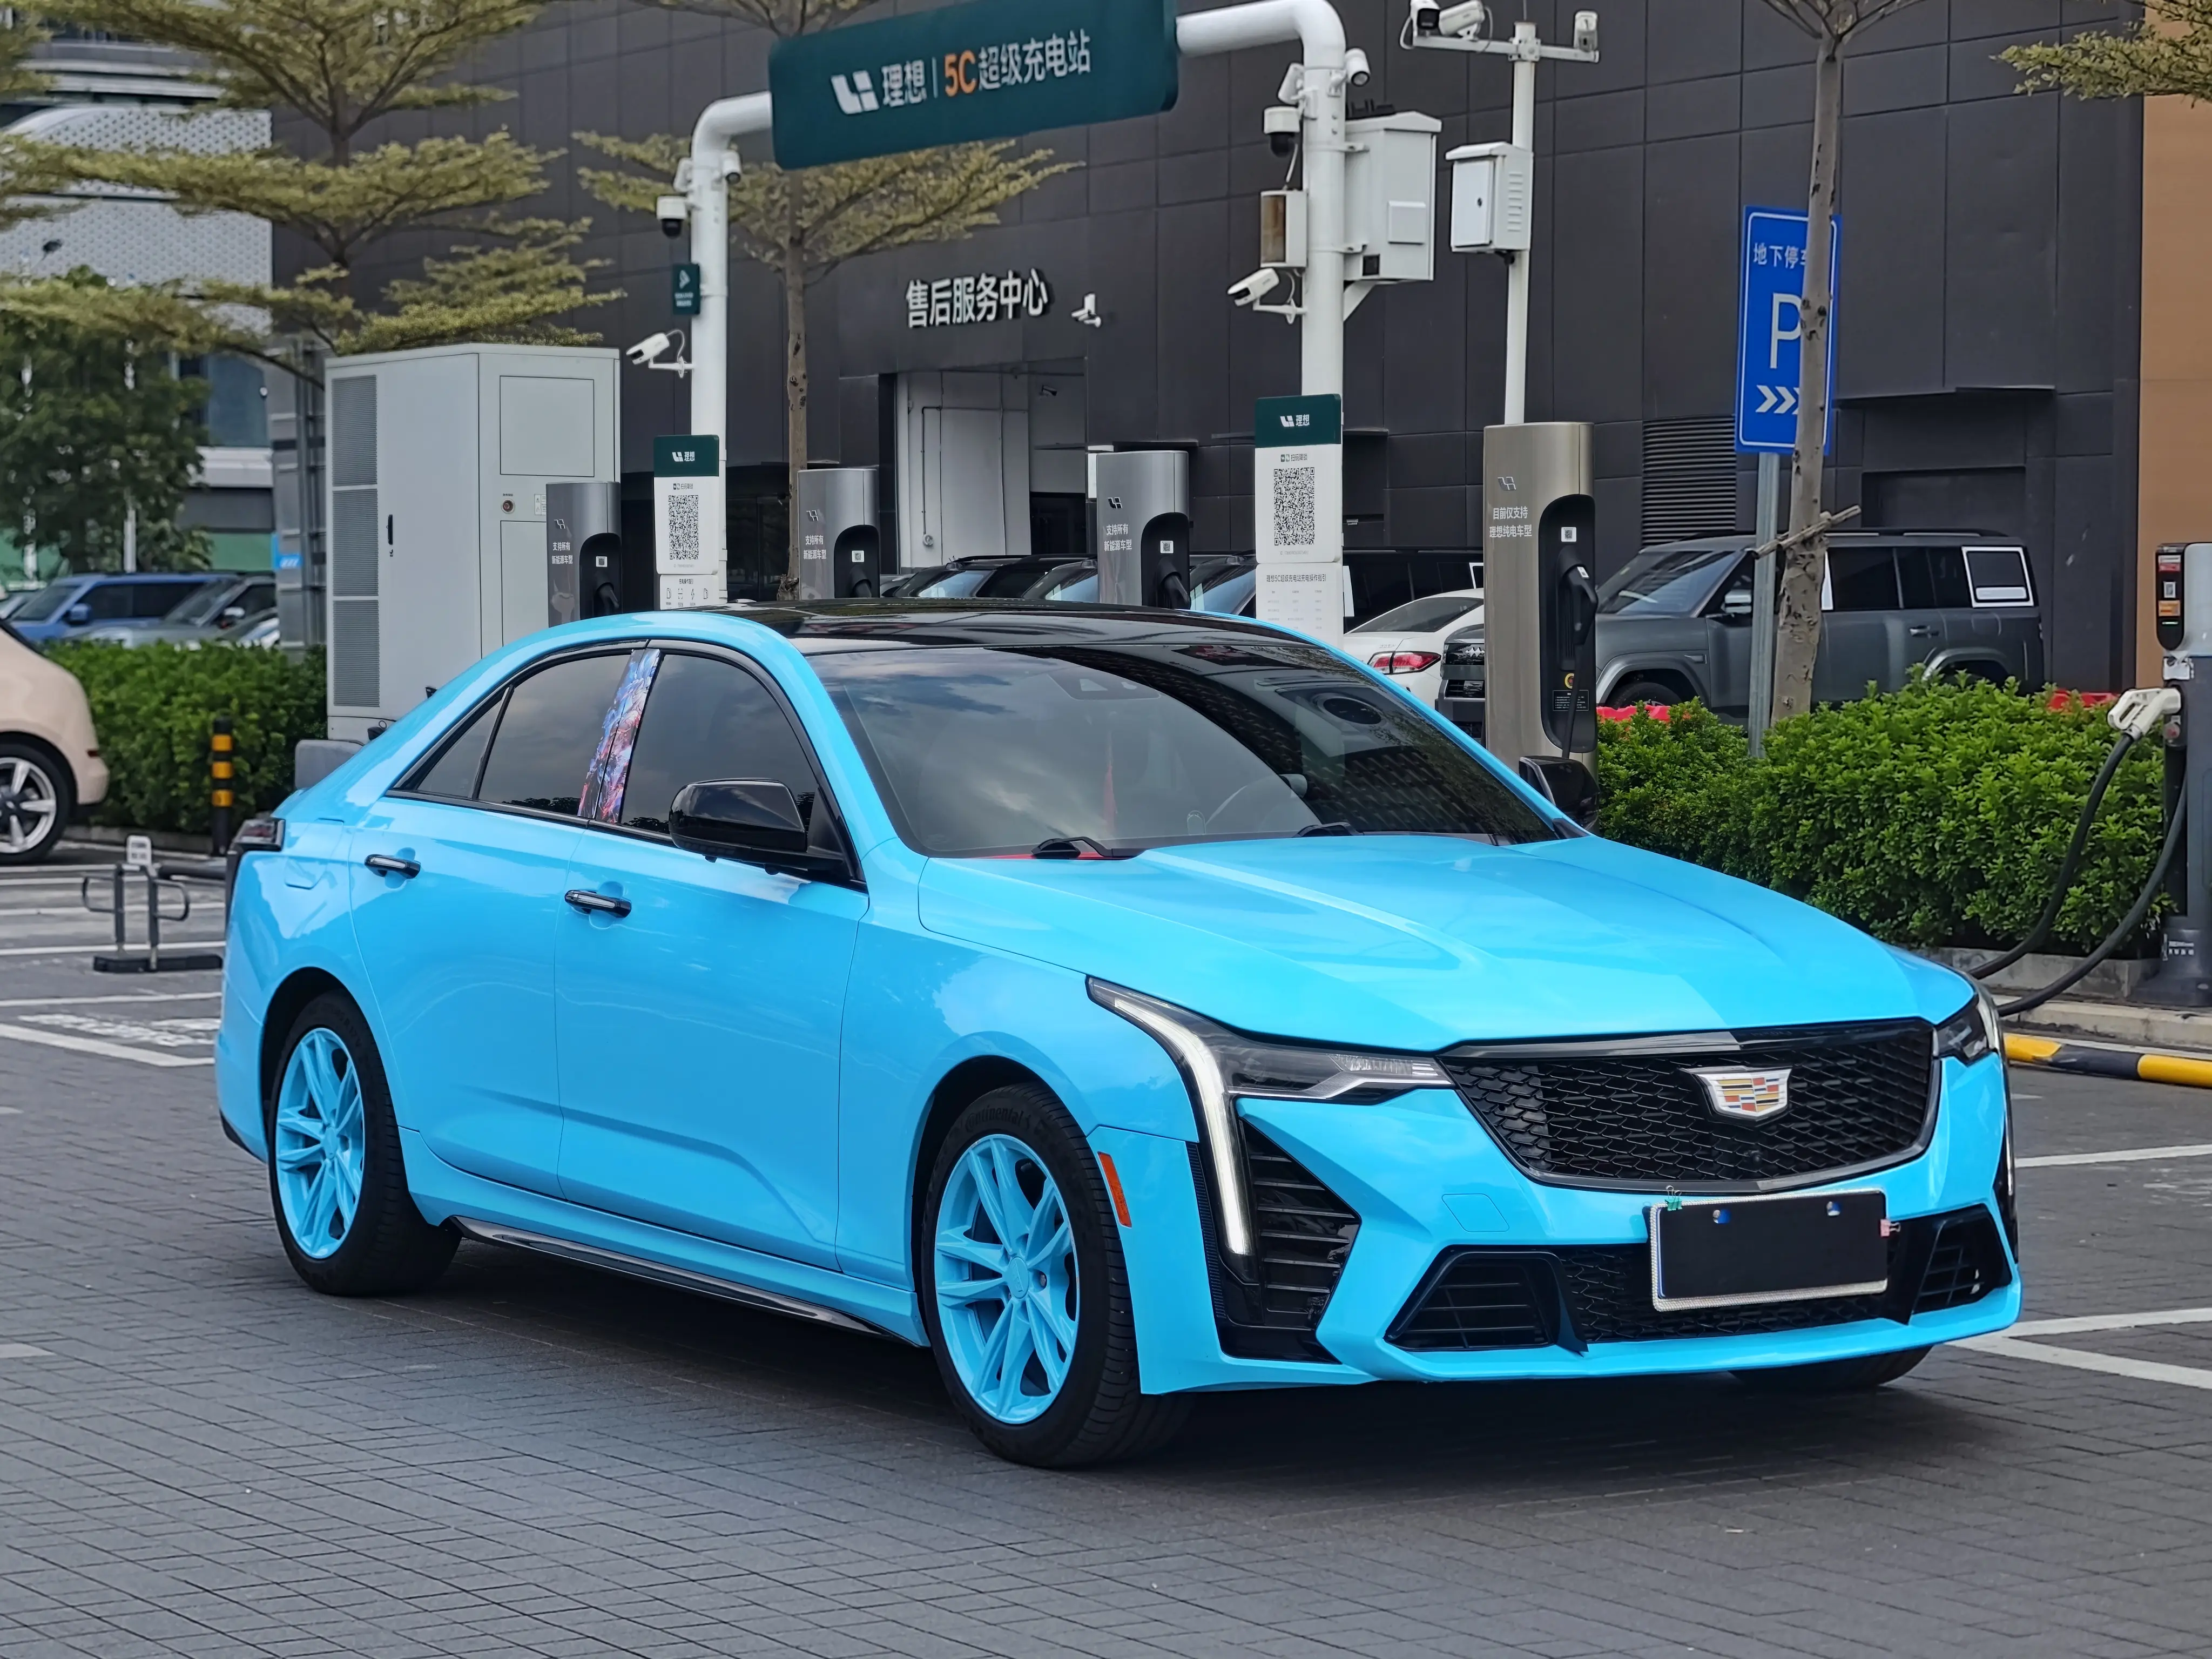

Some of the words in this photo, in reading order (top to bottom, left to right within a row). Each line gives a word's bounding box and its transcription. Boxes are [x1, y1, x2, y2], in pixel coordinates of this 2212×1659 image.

[881, 59, 925, 108] 理想
[944, 29, 1091, 97] 5C超级充电站
[906, 268, 1048, 328] 售后服务中心
[1770, 293, 1802, 369] P
[1296, 414, 1310, 427] 理想
[684, 451, 695, 462] 理想
[1493, 506, 1528, 520] 目前仅支持
[1107, 523, 1129, 536] 支持所有
[1489, 524, 1532, 538] 理想纯电车型
[552, 542, 570, 551] 支持所有
[805, 535, 824, 545] 支持所有
[1104, 539, 1132, 551] 新能源车型
[552, 555, 573, 564] 新能源车型
[803, 549, 827, 560] 新能源车型
[965, 1104, 1024, 1133] Continental
